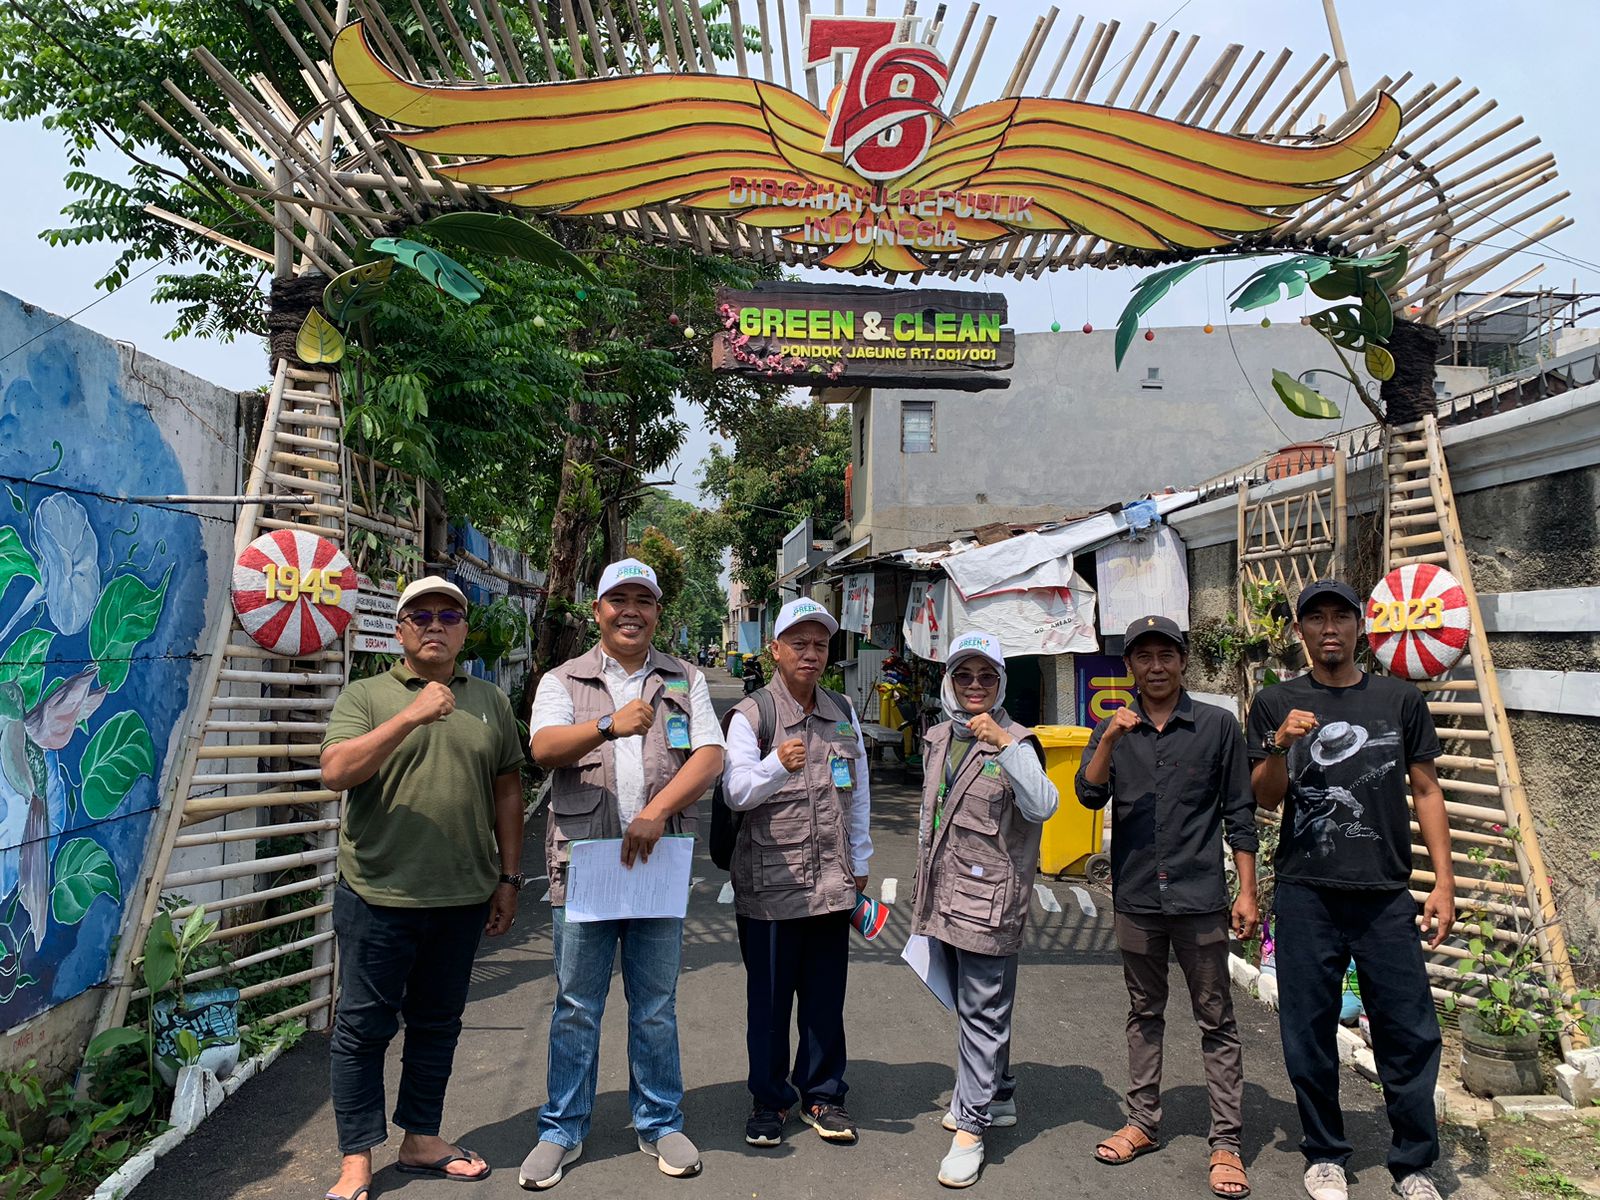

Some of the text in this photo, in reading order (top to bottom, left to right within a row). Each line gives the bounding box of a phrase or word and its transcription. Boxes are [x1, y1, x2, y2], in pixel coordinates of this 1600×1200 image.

[802, 14, 950, 180] 78
[729, 175, 1035, 223] DIRGAHAYU REPUBLIK
[803, 216, 958, 247] INDONESIA
[739, 307, 1001, 343] GREEN & CLEAN
[780, 345, 997, 361] PONDOK JAGUNG RT.001/001
[262, 563, 343, 606] 1945
[1050, 617, 1072, 629] AHEAD
[1371, 596, 1445, 634] 2023
